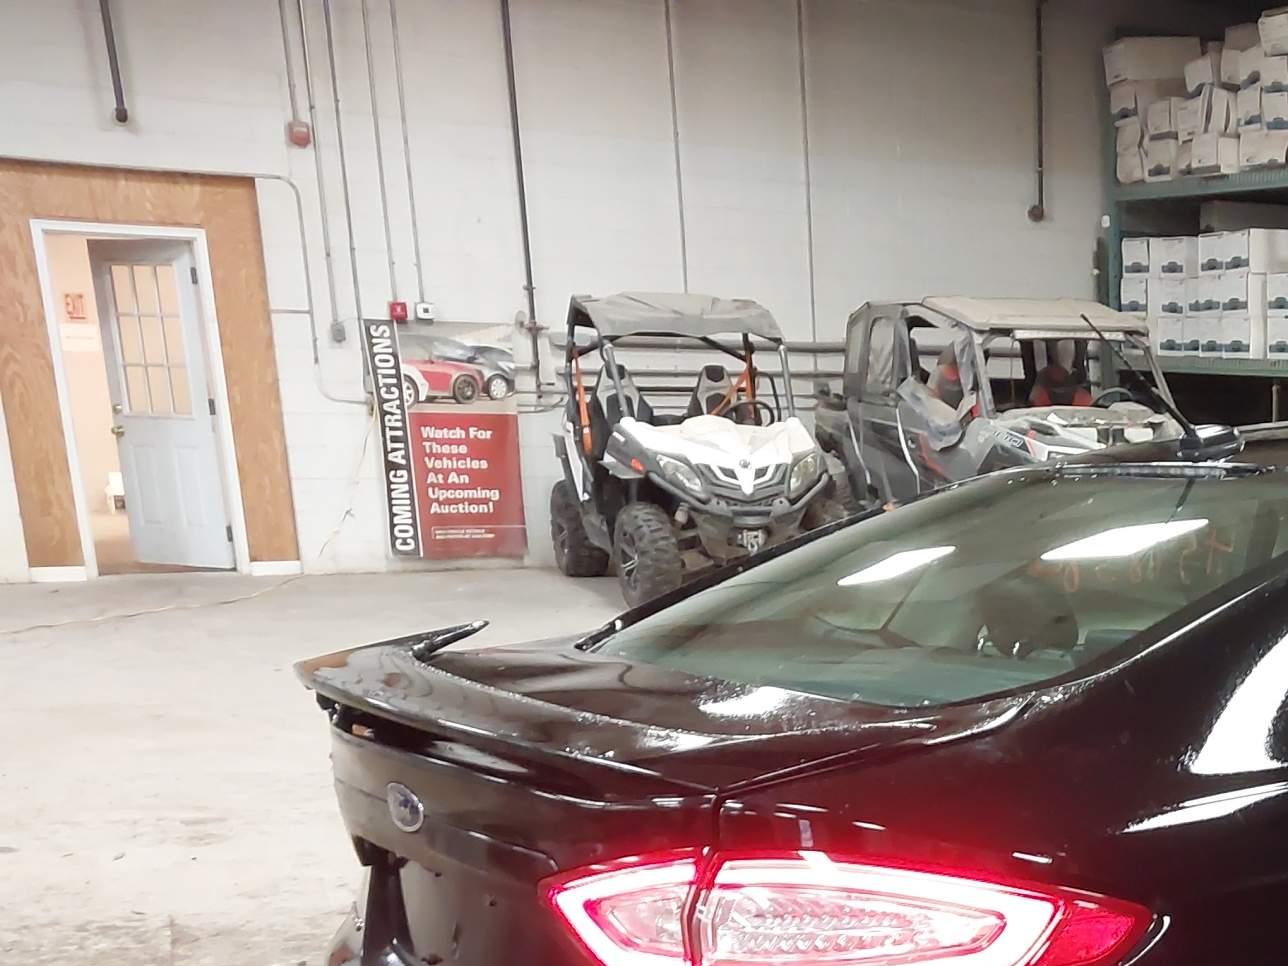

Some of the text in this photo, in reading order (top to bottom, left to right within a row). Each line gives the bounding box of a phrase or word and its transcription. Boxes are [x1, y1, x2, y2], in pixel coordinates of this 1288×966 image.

[370, 324, 415, 551] COMING ATTRACTIONS
[420, 426, 493, 439] Watch For
[422, 441, 468, 454] These
[424, 456, 489, 469] Vehicles
[427, 471, 469, 484] At An
[428, 486, 500, 501] Upcoming
[430, 501, 494, 514] Auction!
